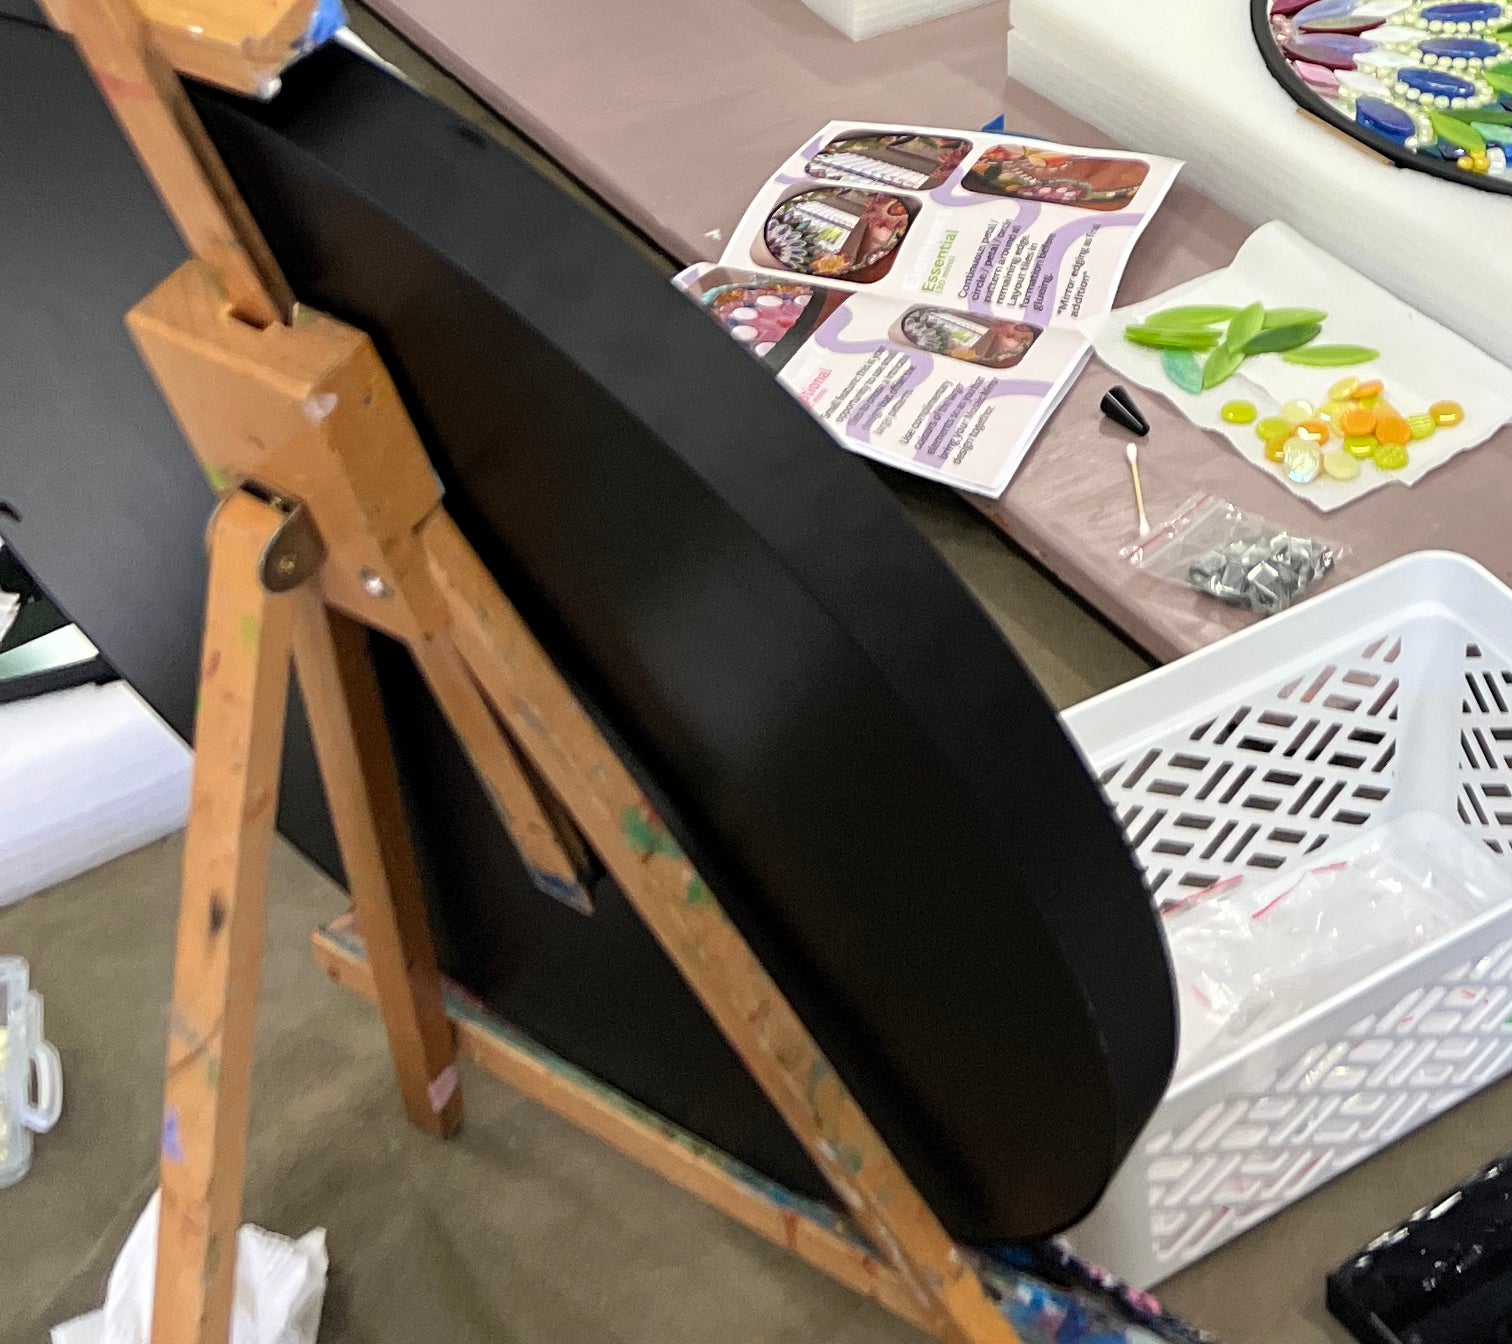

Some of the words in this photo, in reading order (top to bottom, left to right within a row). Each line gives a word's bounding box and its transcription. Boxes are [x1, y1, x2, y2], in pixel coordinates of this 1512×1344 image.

[922, 229, 959, 293] Essential
[957, 245, 987, 299] Continuous
[981, 224, 998, 245] petal
[972, 272, 989, 301] circle
[984, 243, 1001, 267] petal
[984, 266, 1003, 304] pattern
[999, 234, 1018, 266] around
[996, 256, 1022, 305] remaining
[1007, 272, 1026, 306] Layout
[1020, 251, 1035, 271] tiles
[1019, 260, 1045, 309] formation
[1071, 247, 1091, 277] edging
[836, 384, 871, 422] opportunity
[899, 428, 916, 445] Use
[912, 379, 954, 429] complimentary
[914, 421, 937, 450] colours
[927, 418, 955, 455] elements
[937, 437, 960, 460] bring
[953, 437, 974, 465] design
